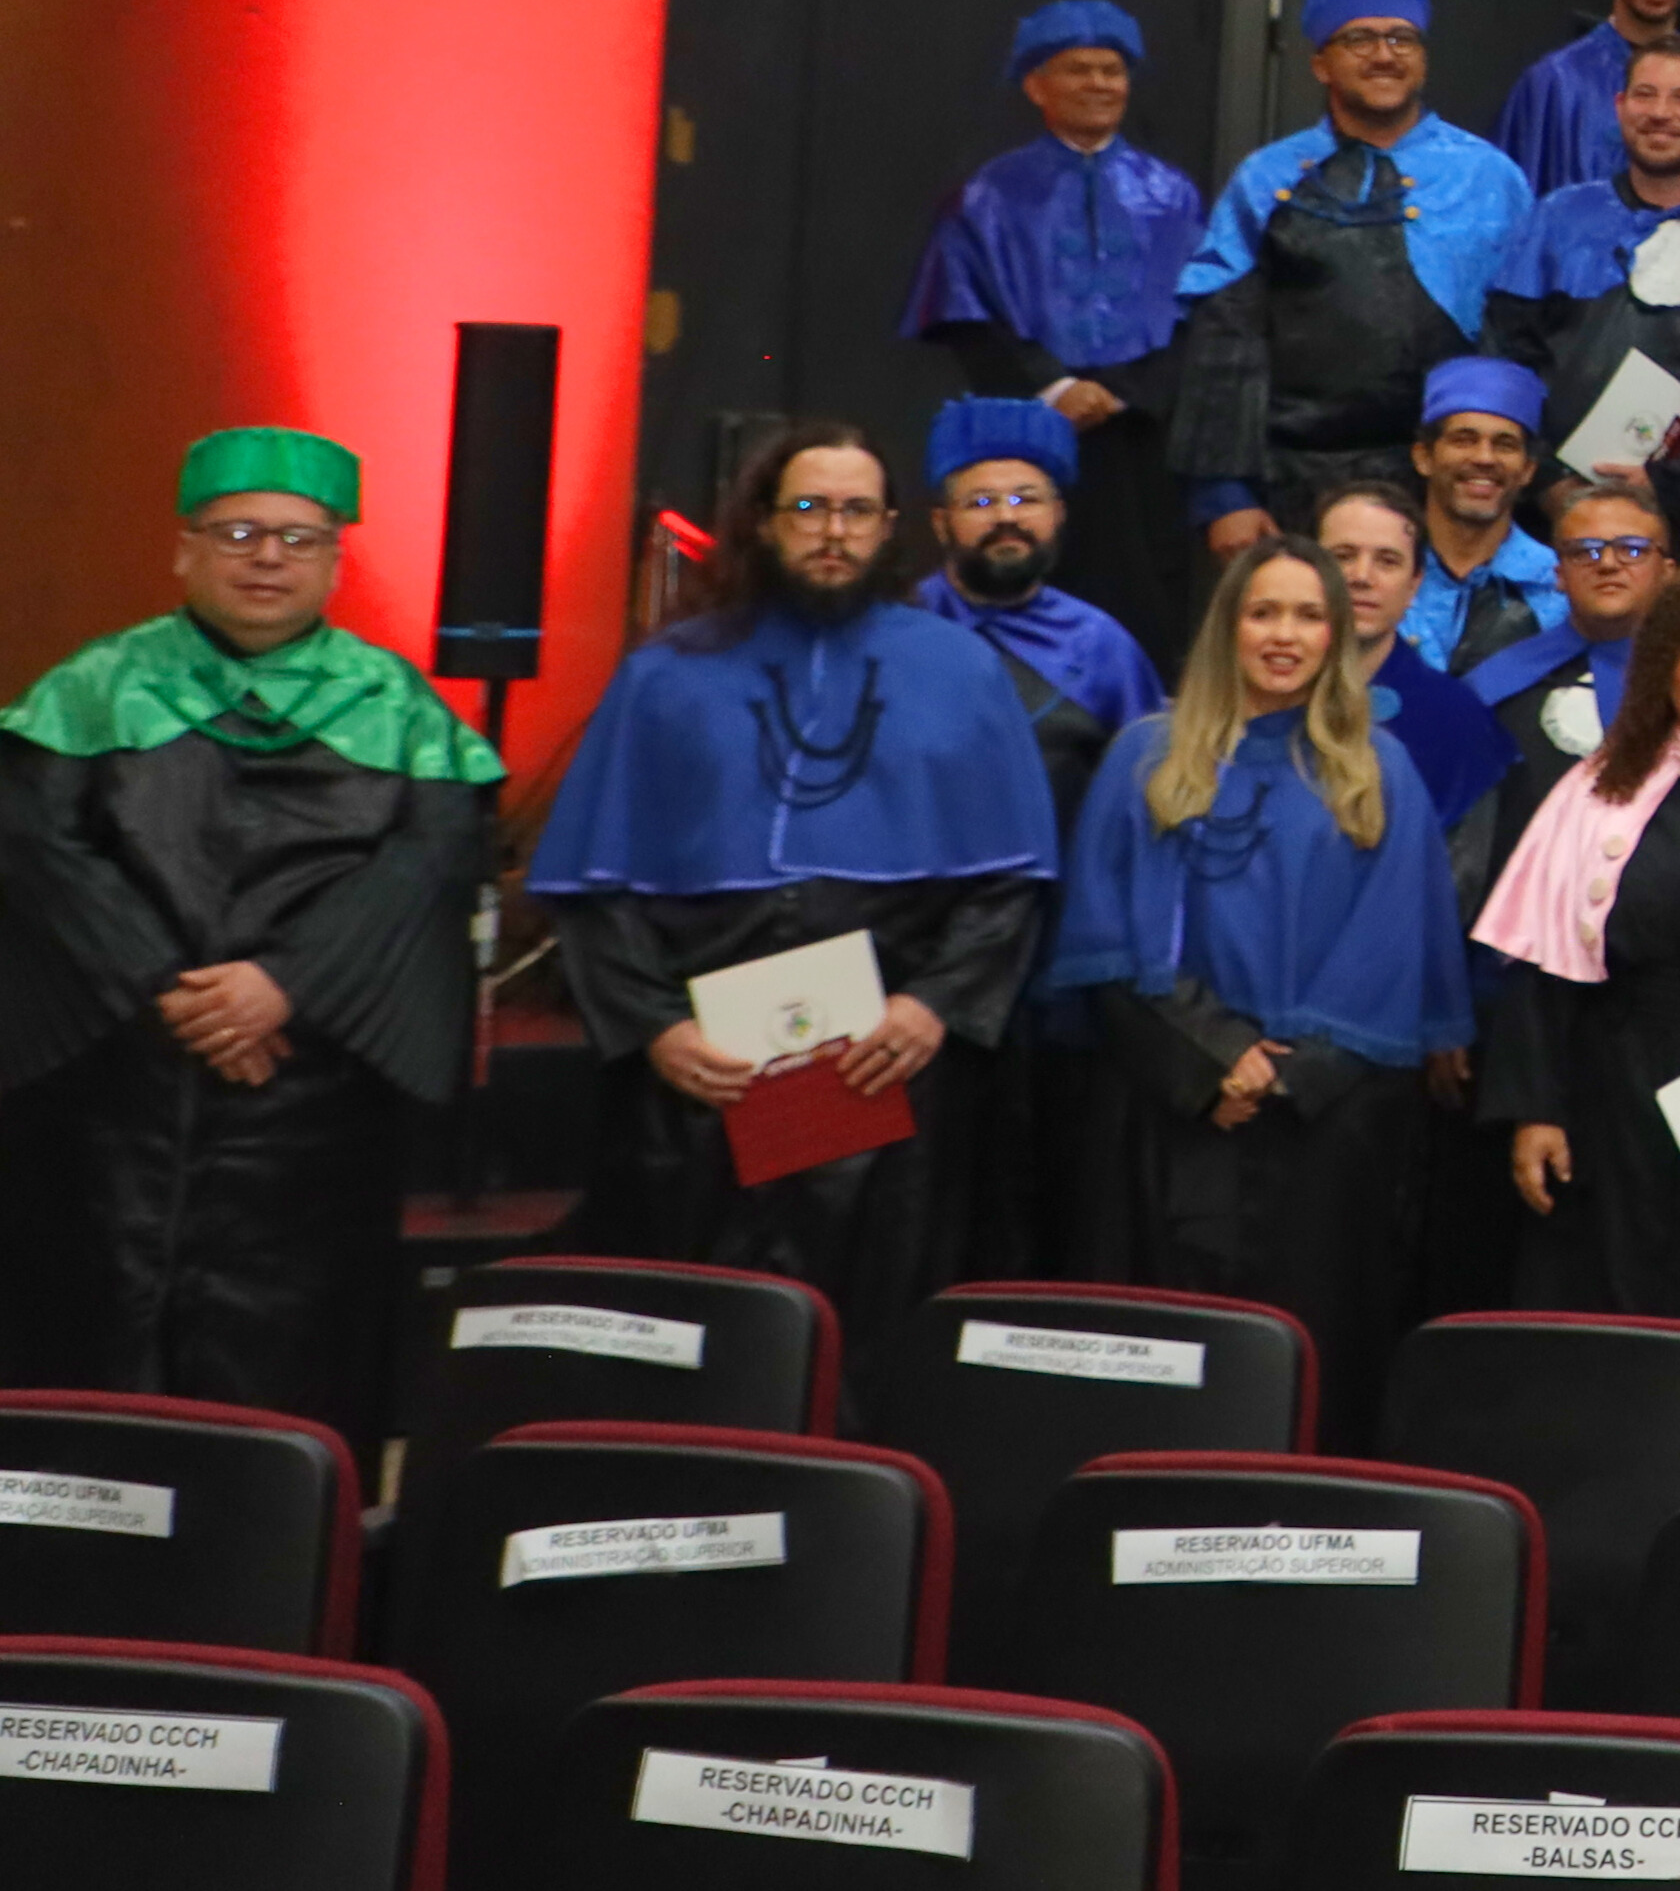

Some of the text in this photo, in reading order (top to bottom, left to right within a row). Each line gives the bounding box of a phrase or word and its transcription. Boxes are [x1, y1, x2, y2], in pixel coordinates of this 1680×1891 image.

[549, 1523, 676, 1550] RESERVADO
[1175, 1534, 1355, 1553] RESERVADO UFMA
[1290, 1557, 1384, 1574] SUPERIOR
[0, 1717, 219, 1749] RESERVADO CCCH
[17, 1750, 186, 1778] -CHAPADINHA-
[699, 1766, 935, 1810] RESERVADO CCCH
[721, 1801, 902, 1837] -CHAPADINHA-
[1472, 1813, 1630, 1838] RESERVADO
[1522, 1847, 1645, 1871] -BALSAS-
